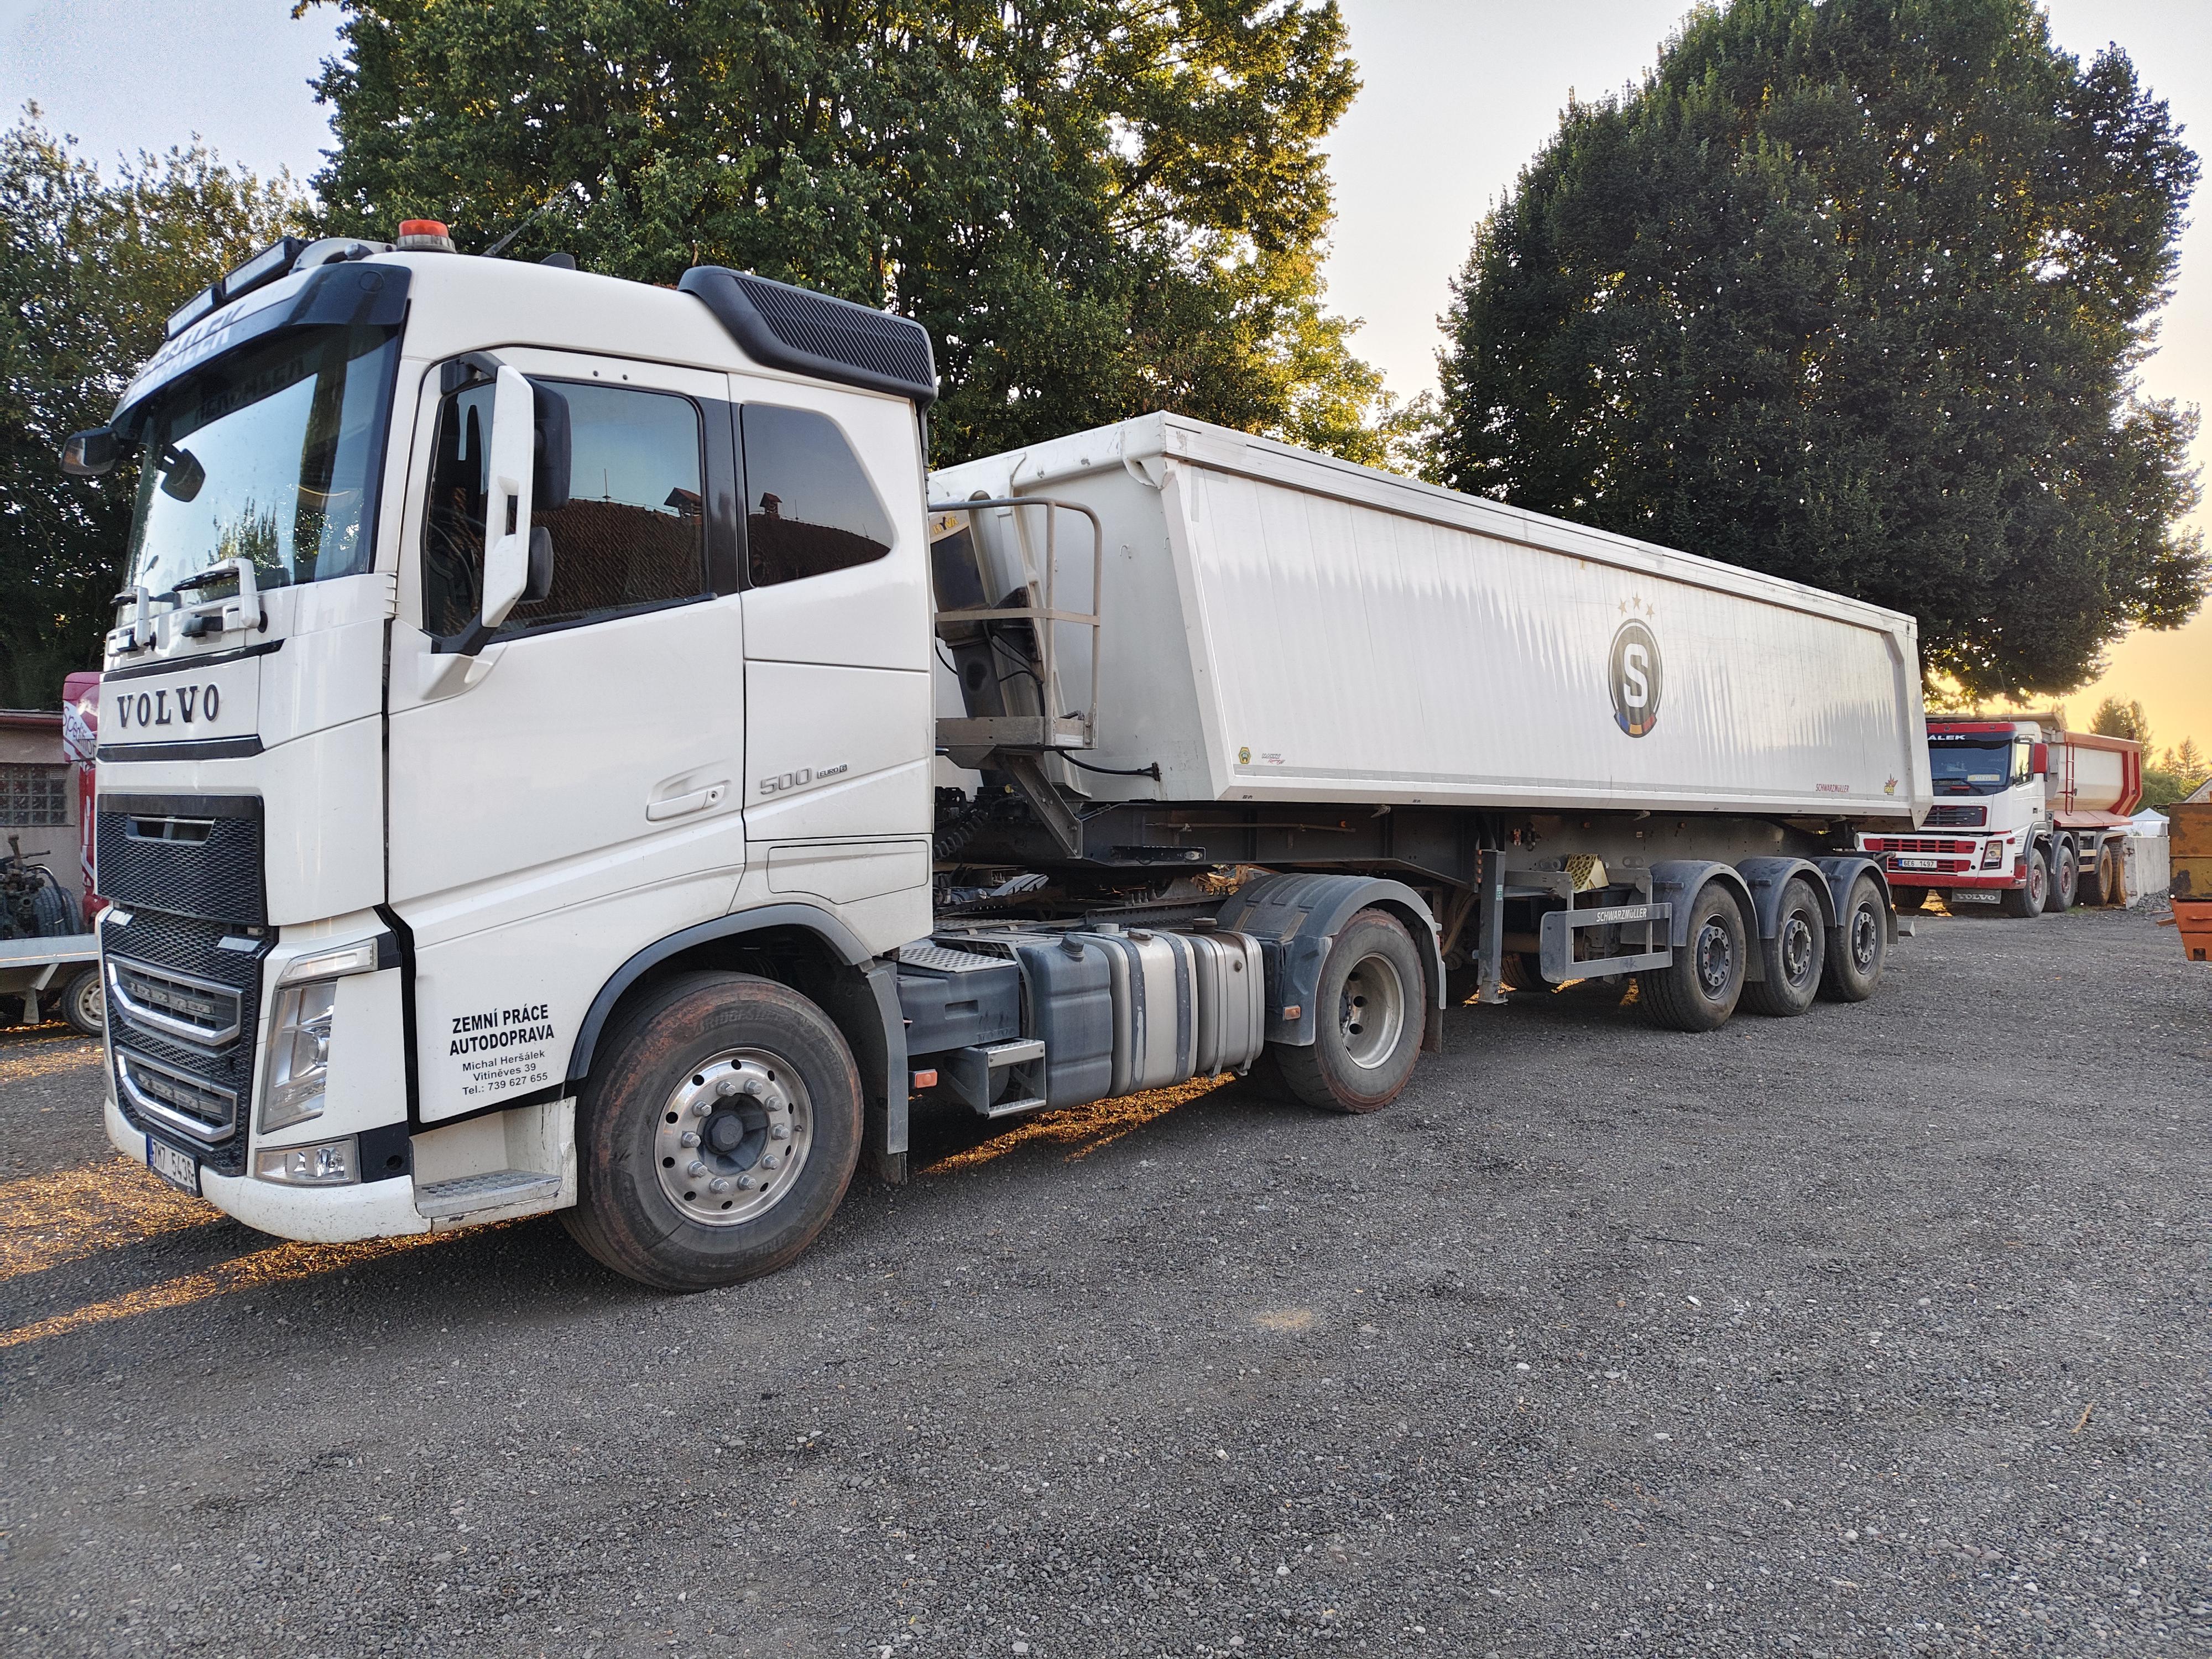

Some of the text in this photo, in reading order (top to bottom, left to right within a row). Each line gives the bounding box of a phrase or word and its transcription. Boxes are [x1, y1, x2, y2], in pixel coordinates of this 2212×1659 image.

[1624, 643, 1648, 707] S
[117, 683, 220, 728] VOLVO
[760, 768, 812, 795] 500
[820, 767, 838, 777] EURO
[452, 1004, 549, 1034] ZEMNÍ PRÁCE
[450, 1024, 555, 1056] AUTODOPRAVA
[462, 1050, 545, 1072] Michal Heršálek
[473, 1063, 536, 1081] Vitiněves 39
[462, 1072, 548, 1095] Tel.: 739 627 655
